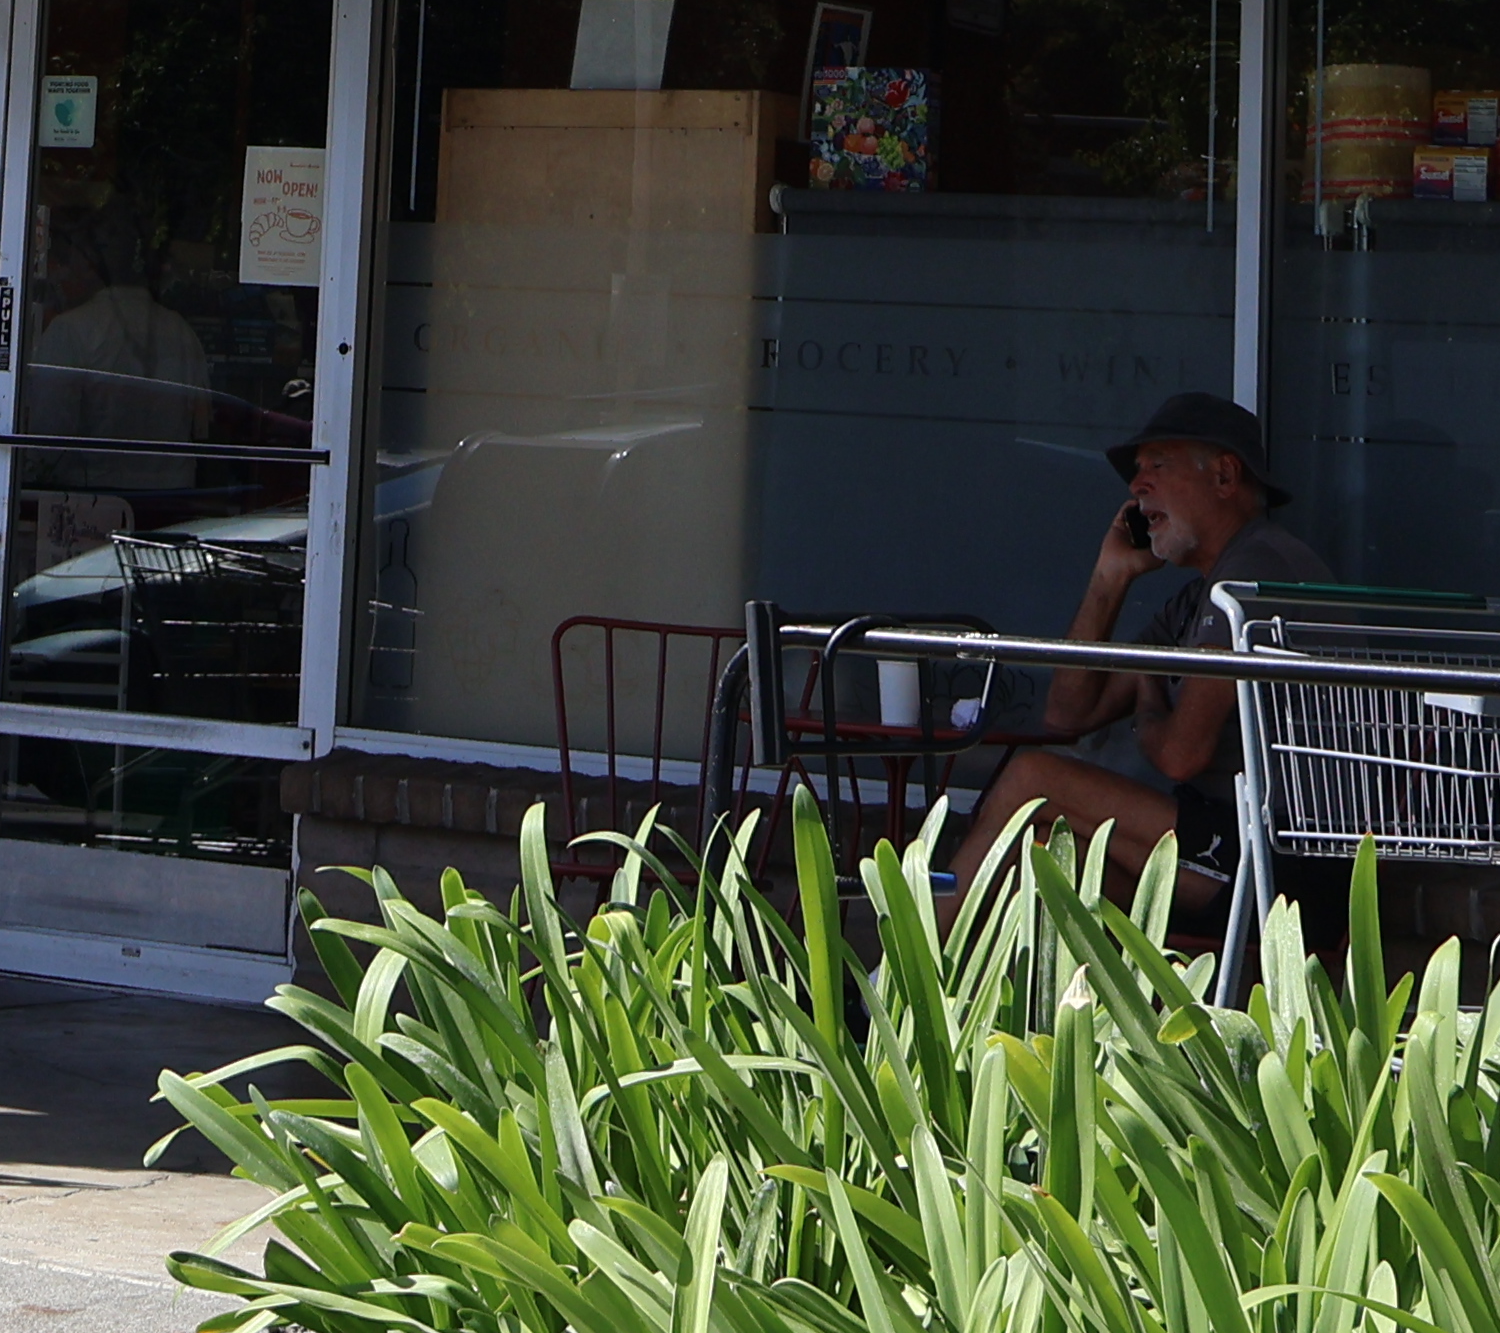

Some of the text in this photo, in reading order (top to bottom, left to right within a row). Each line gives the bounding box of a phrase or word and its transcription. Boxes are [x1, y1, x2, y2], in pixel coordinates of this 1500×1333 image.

[257, 169, 283, 184] NOW
[282, 181, 318, 198] OPEN!
[0, 296, 11, 346] PULL
